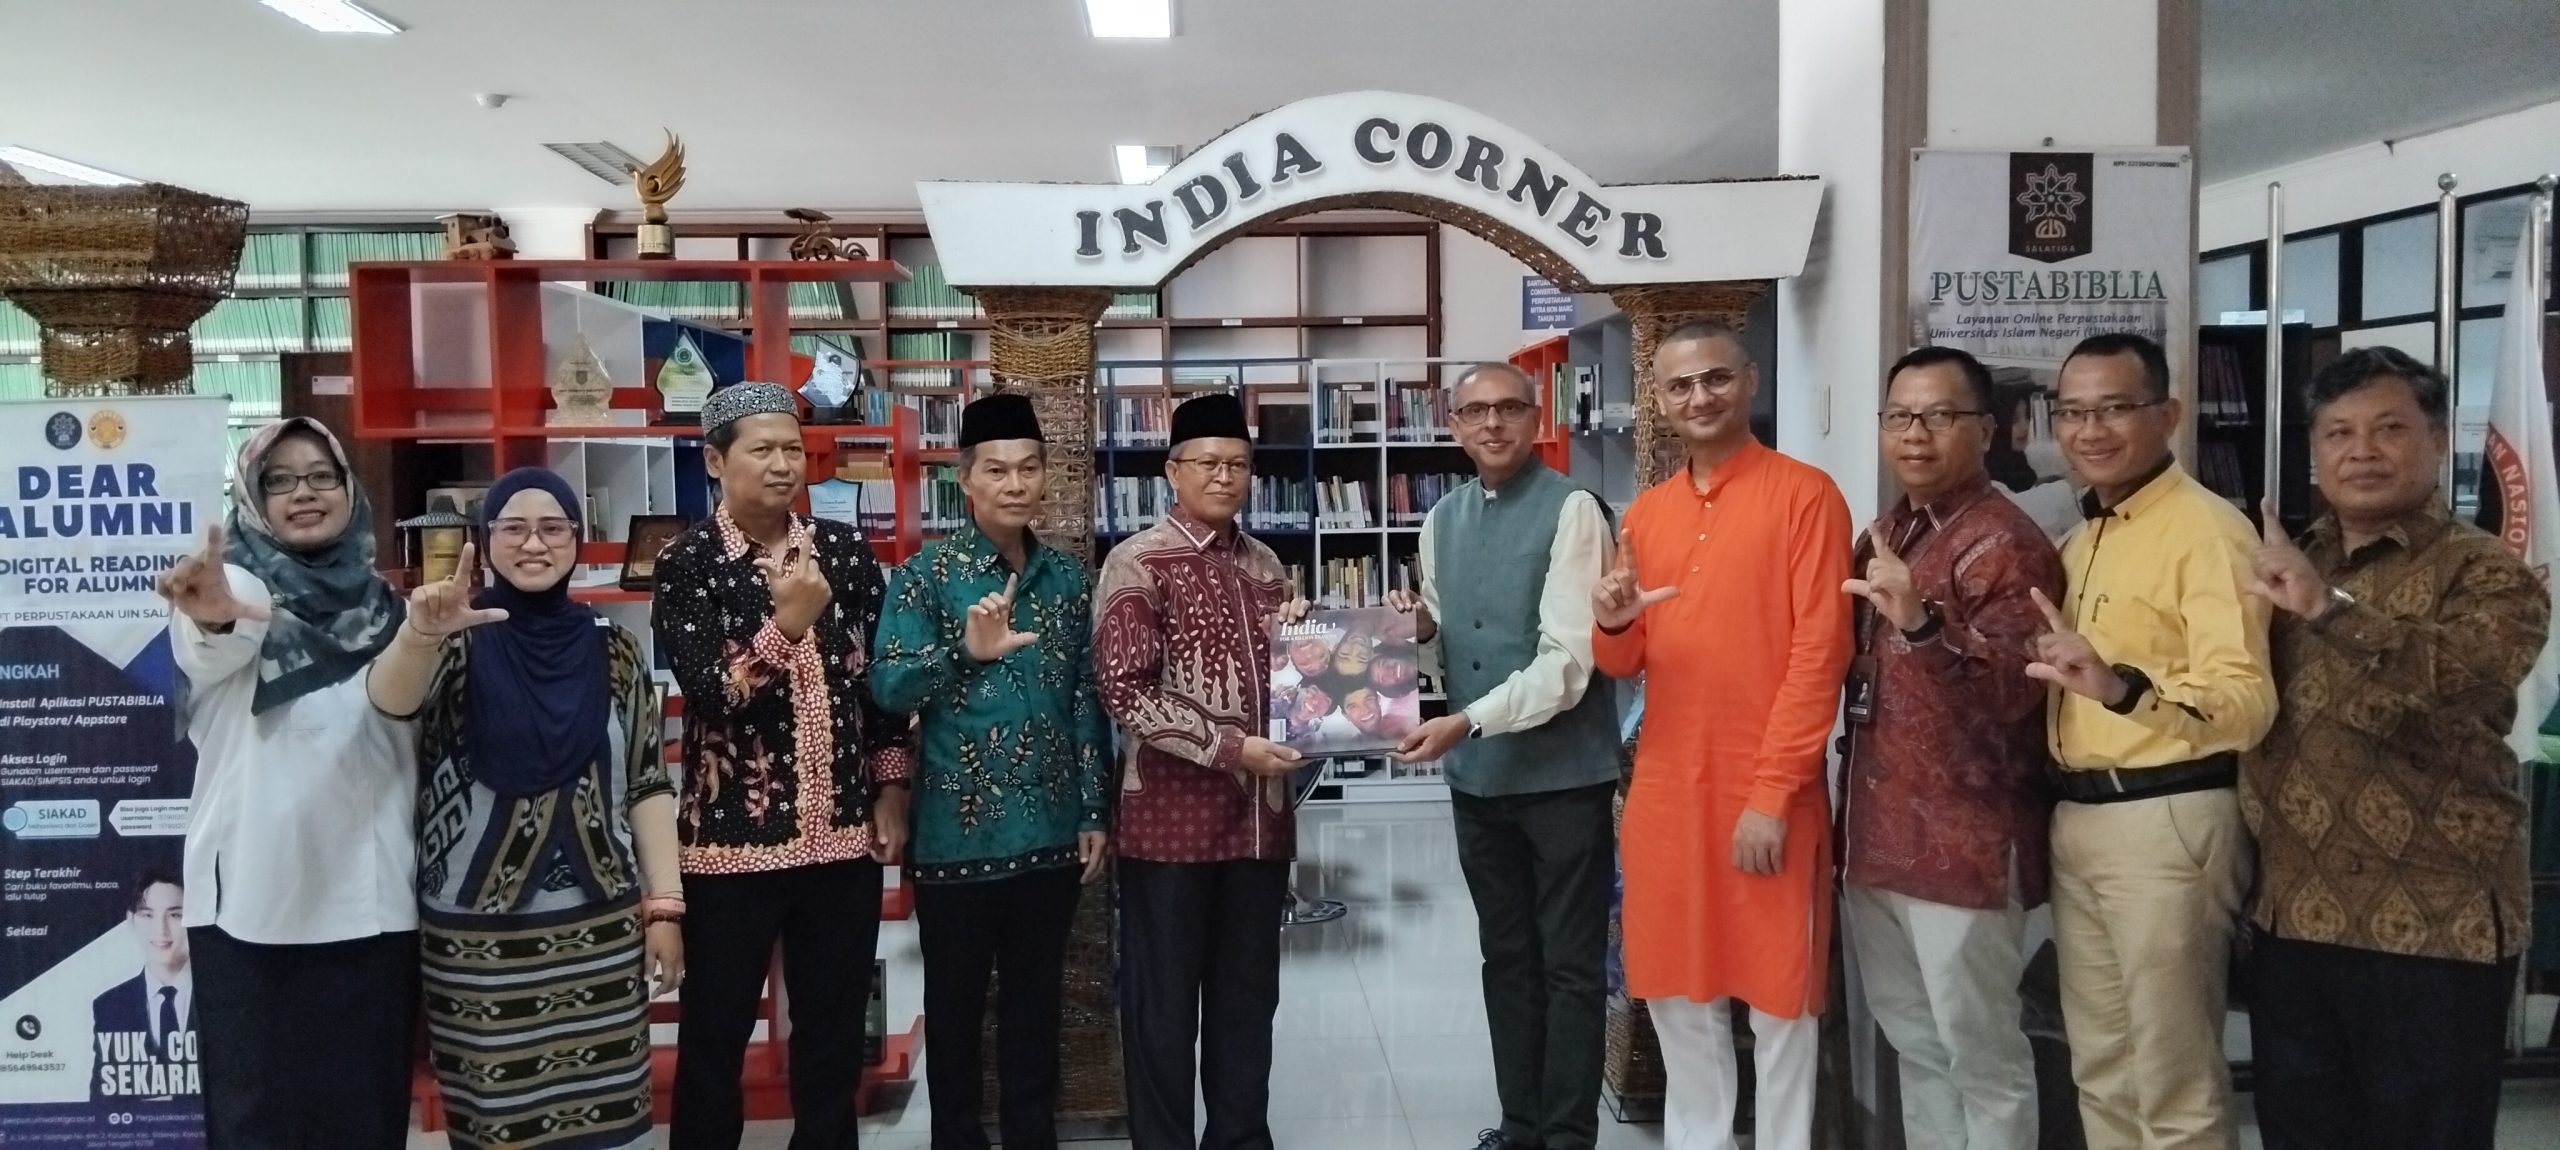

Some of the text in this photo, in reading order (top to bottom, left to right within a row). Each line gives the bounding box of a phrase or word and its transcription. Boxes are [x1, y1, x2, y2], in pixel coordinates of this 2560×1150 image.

[1076, 116, 1669, 260] INDIA CORNER
[2025, 244, 2076, 252] SALATIGA
[1931, 270, 2168, 303] PUSTABIBLIA
[1956, 313, 2141, 326] Layanan Online Perpustakaan
[1930, 328, 1999, 339] Universitas
[2003, 327, 2035, 338] Islam
[2040, 327, 2079, 340] Negeri
[18, 463, 159, 500] DEAR
[0, 502, 192, 538] ALUMNI
[0, 557, 84, 575] DIGITAL
[25, 575, 161, 594] FOR ALUMN
[15, 610, 114, 621] PERPUSTAKAAN
[118, 609, 140, 619] UIN
[40, 696, 86, 710] Aplikasi
[88, 695, 165, 707] PUSTABIBLIA
[74, 715, 128, 728] Appstore
[1, 752, 67, 766] Akses Login
[1, 764, 158, 776] Gunakan username dan password
[73, 776, 98, 785] anda
[100, 776, 126, 784] untuk
[128, 775, 151, 786] login
[38, 808, 87, 820] SIAKAD
[150, 805, 168, 814] Login
[4, 867, 82, 881] Step Terakhir
[4, 883, 23, 891] Cari
[5, 892, 47, 902] lalu tutup
[6, 925, 48, 937] Selesai
[98, 1031, 157, 1065] YUK,
[6, 1050, 54, 1060] Help Desk
